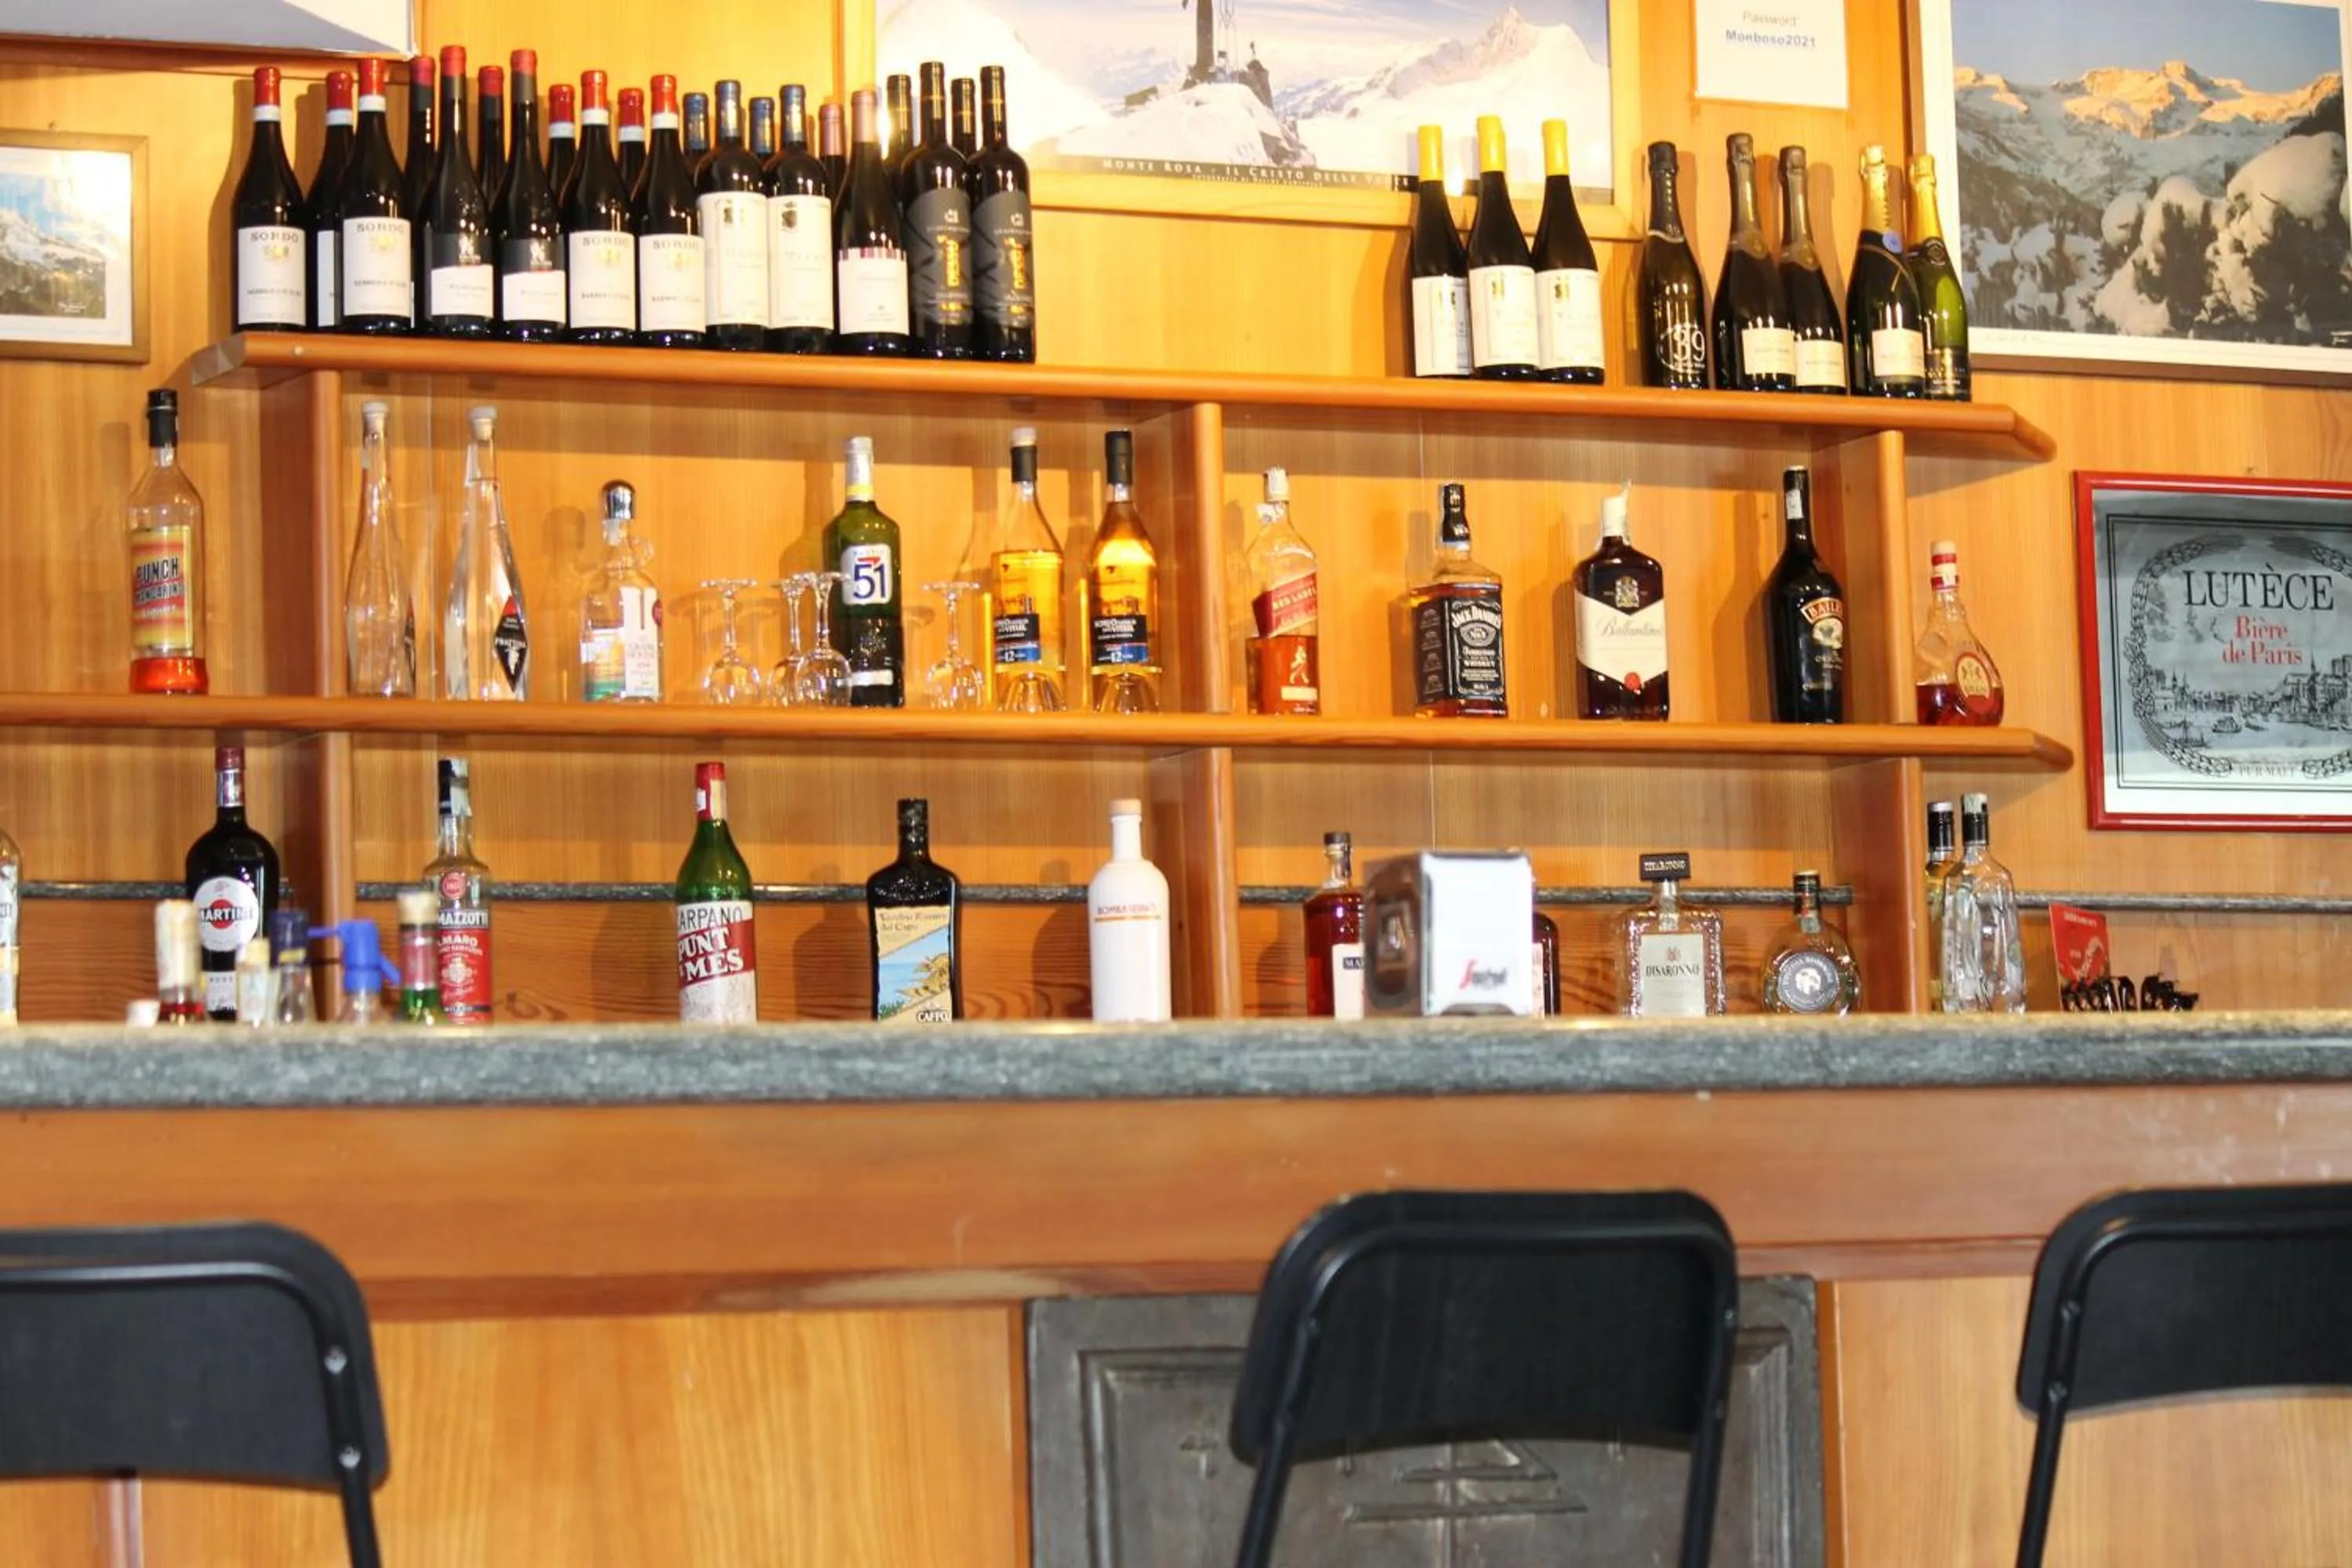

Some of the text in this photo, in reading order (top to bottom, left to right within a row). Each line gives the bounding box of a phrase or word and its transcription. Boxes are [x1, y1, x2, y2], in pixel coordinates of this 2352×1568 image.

[1726, 29, 1816, 48] Monboso2021
[1102, 159, 1154, 172] MONTE
[1164, 162, 1202, 173] ROSA
[1226, 166, 1240, 176] IL
[1249, 167, 1305, 180] CRISTO
[1314, 171, 1356, 183] DELLE
[853, 564, 886, 600] 51
[2183, 562, 2334, 611] LUTÈCE
[2236, 615, 2288, 639] Bière
[2222, 639, 2303, 665] de Paris
[679, 906, 742, 931] ARPANO
[685, 947, 743, 982] MES
[1646, 965, 1699, 978] DISARONNO
